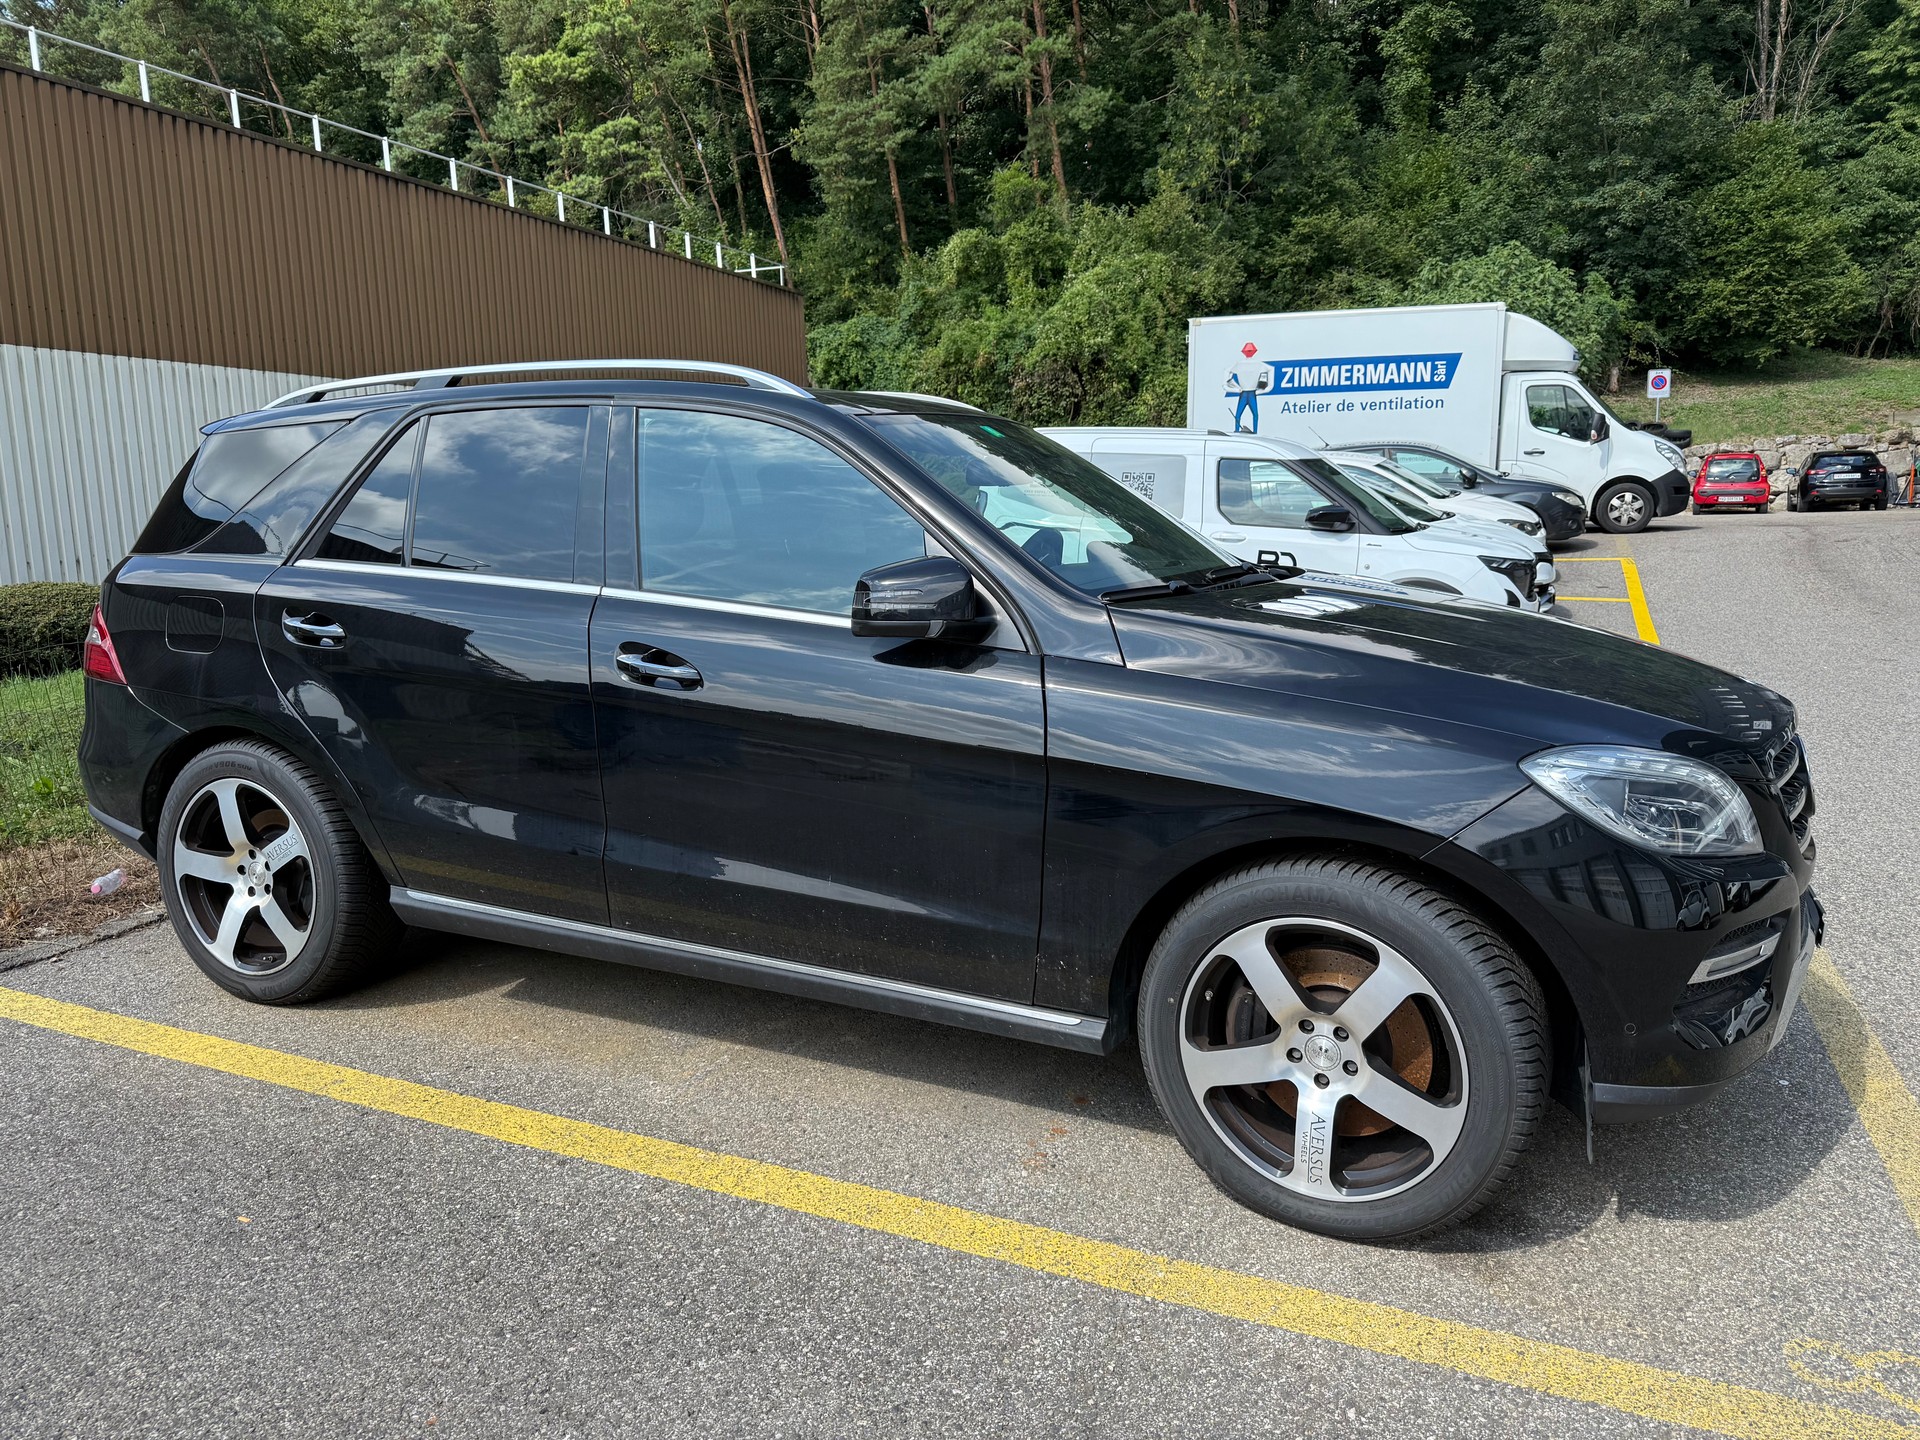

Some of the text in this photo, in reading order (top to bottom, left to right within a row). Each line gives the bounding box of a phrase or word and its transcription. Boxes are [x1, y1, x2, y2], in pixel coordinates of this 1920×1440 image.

[1281, 361, 1447, 388] ZIMMERMANN Sàrl
[1281, 396, 1444, 414] Atelier de ventilation
[267, 834, 298, 860] AVERSUS
[1301, 1131, 1309, 1164] WHEELS
[1310, 1110, 1326, 1186] AVERSUS
